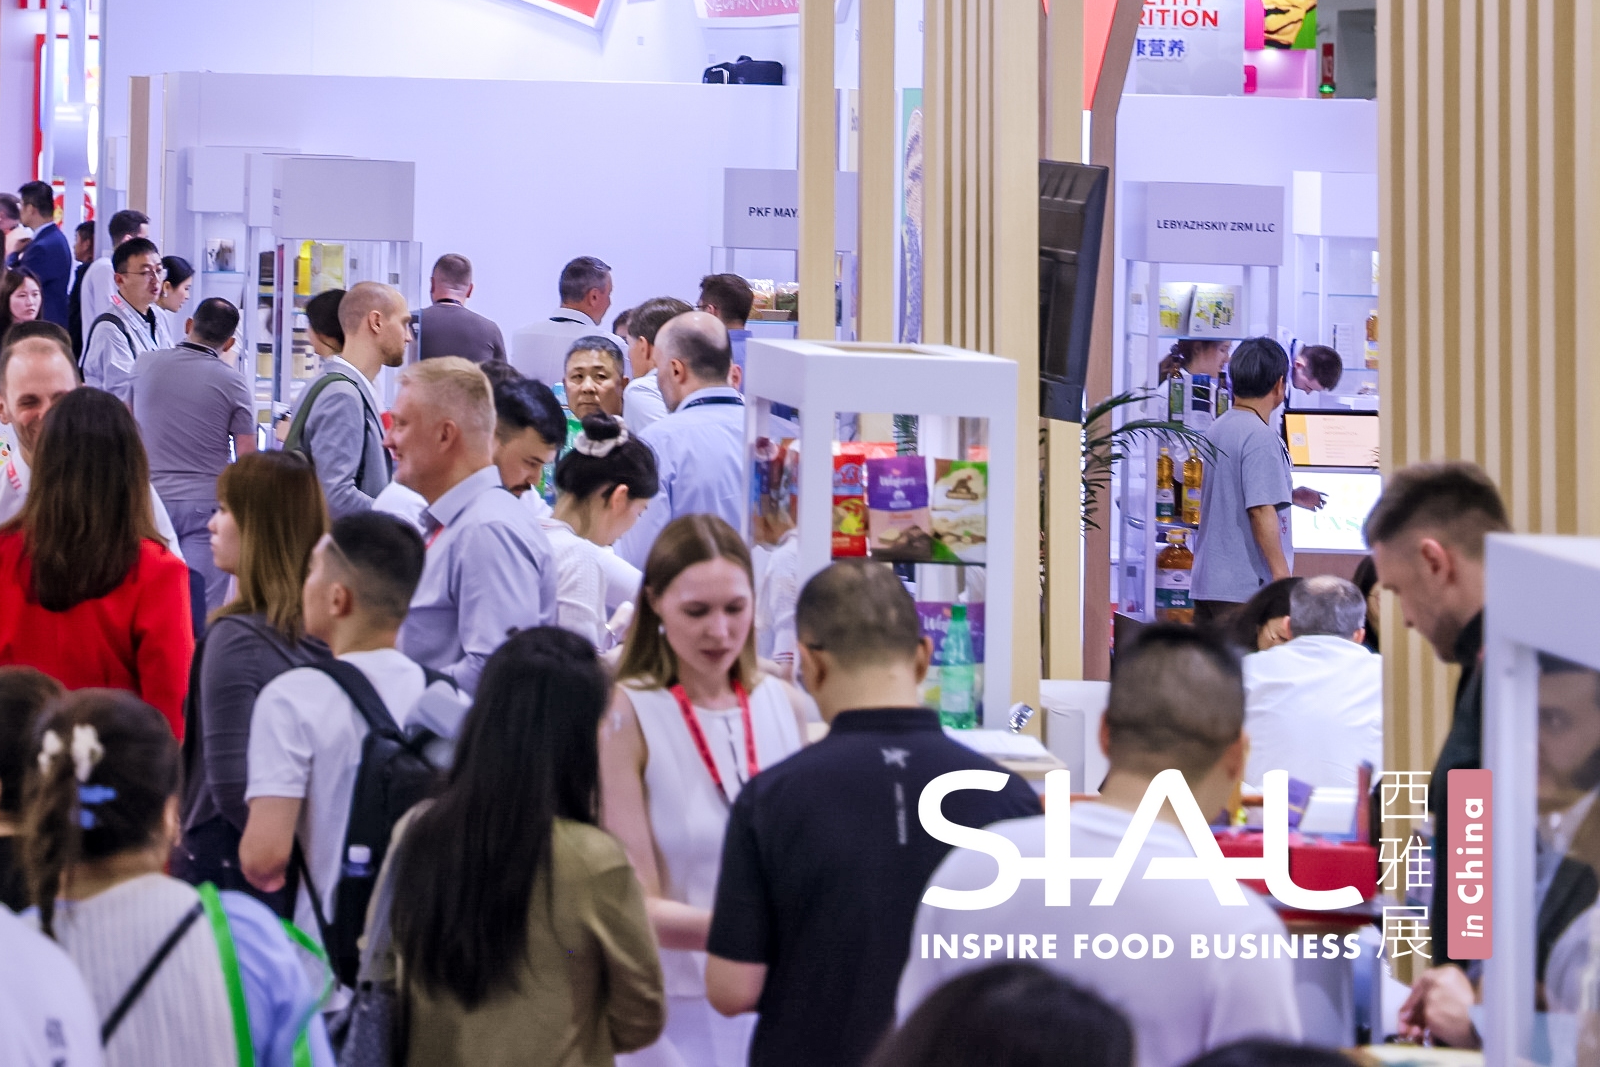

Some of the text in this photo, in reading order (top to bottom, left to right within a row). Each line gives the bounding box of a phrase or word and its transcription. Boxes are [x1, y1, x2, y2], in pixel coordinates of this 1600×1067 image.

[748, 206, 799, 219] PKF MAY
[1156, 219, 1229, 231] LEBYAZHSKIY
[1255, 222, 1276, 233] LLC
